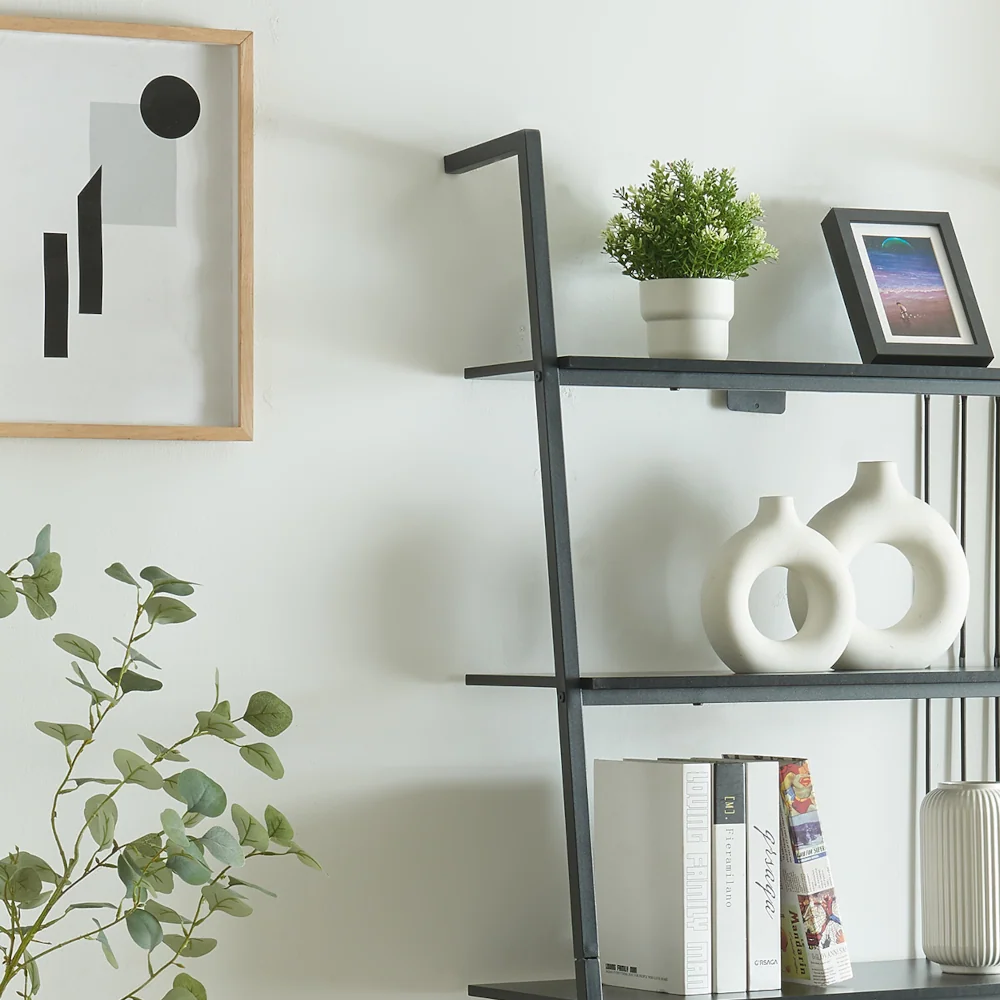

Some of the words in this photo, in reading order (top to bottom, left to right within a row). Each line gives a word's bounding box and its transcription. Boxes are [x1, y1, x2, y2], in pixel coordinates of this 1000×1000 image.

[686, 770, 709, 843] LOVING
[686, 852, 709, 931] FAMILY
[725, 828, 735, 908] Fieramilano
[686, 941, 709, 990] MAN
[788, 910, 807, 976] Mandarin
